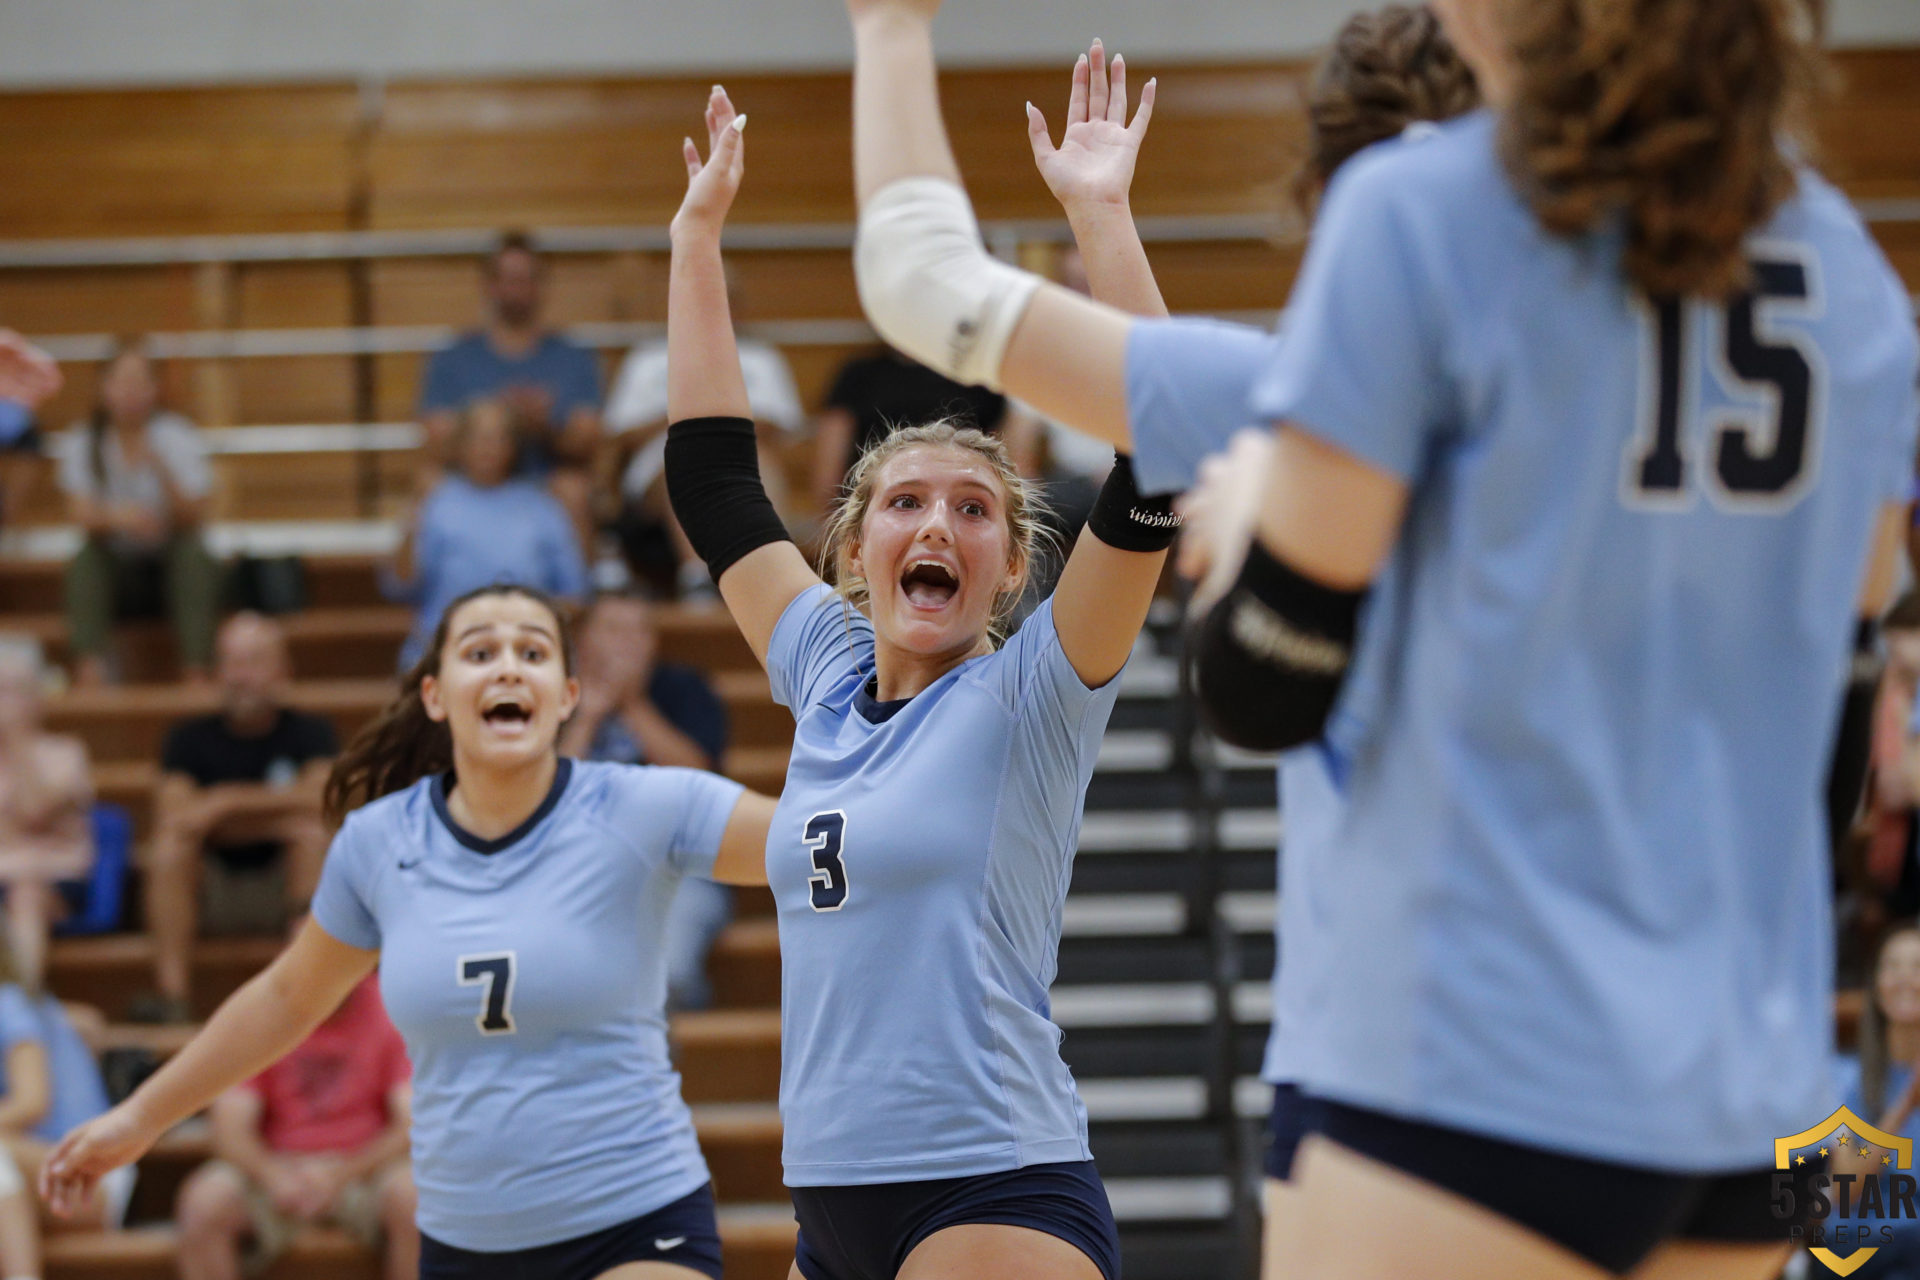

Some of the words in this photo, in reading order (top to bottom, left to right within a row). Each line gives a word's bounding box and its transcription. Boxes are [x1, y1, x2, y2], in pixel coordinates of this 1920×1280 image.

[1622, 241, 1827, 513] 15
[802, 809, 849, 913] 3
[457, 951, 516, 1036] 7
